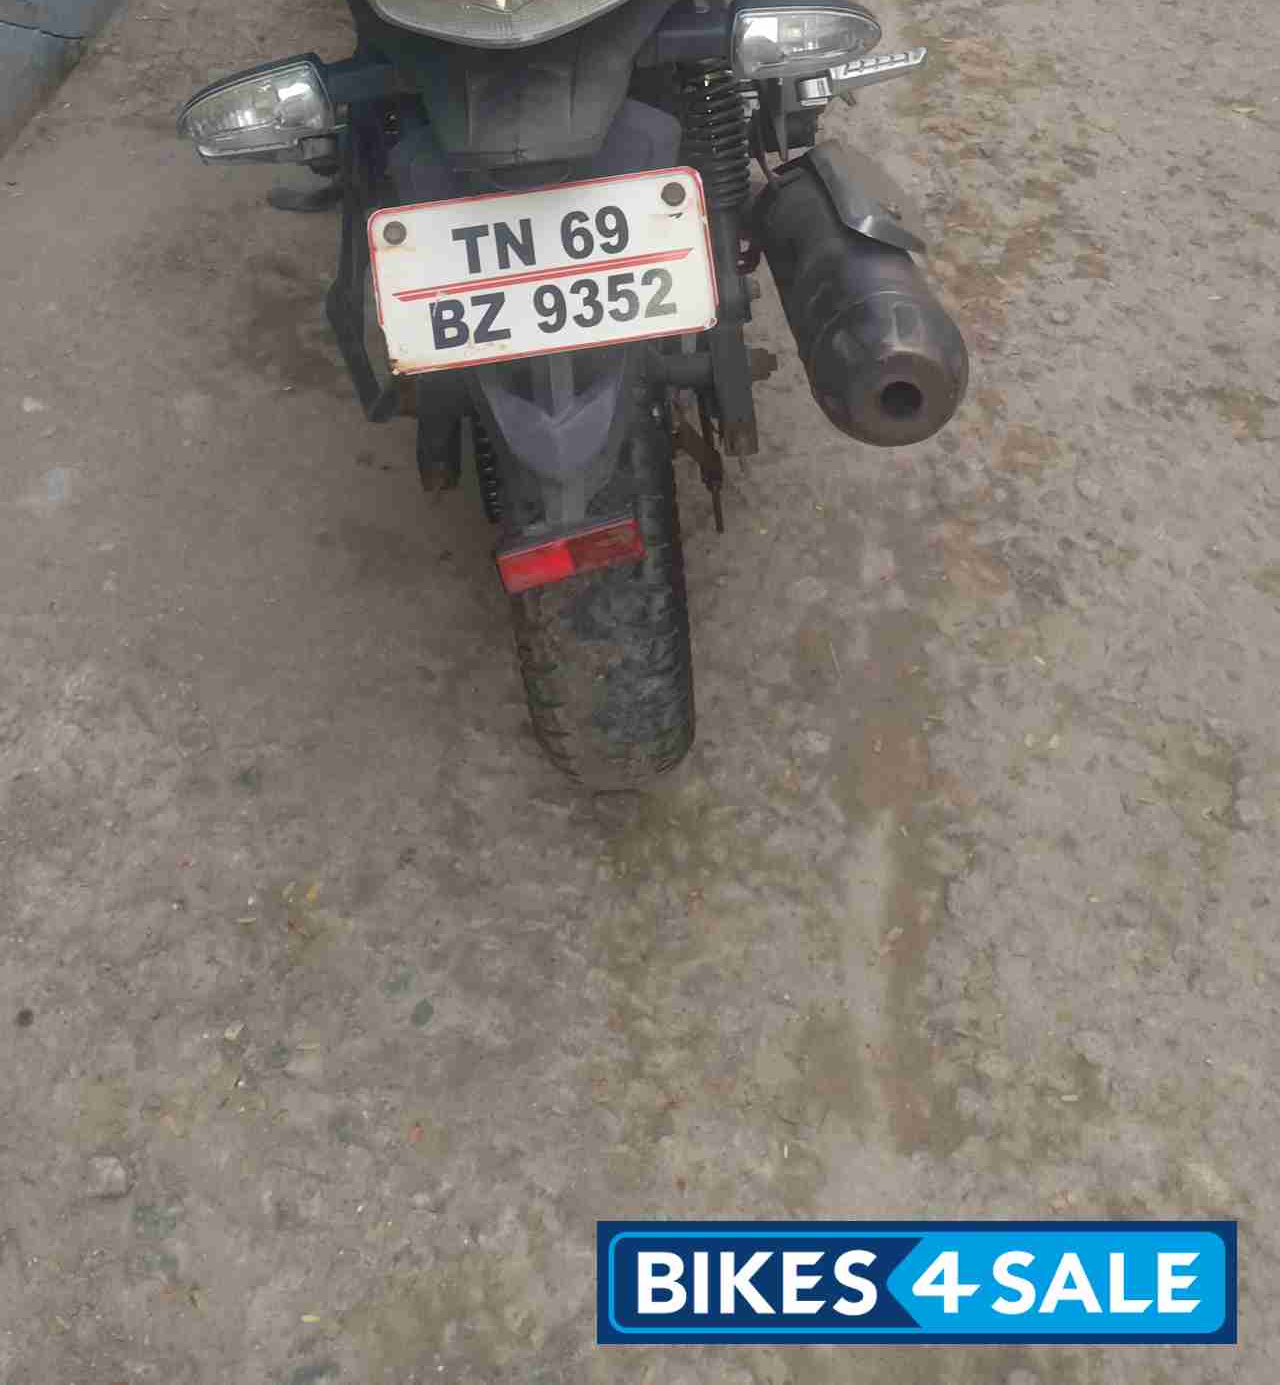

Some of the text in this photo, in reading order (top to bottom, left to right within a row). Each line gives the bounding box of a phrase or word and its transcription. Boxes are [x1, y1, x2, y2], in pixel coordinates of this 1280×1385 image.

[451, 205, 630, 275] TN 69
[428, 267, 678, 351] BZ 9352
